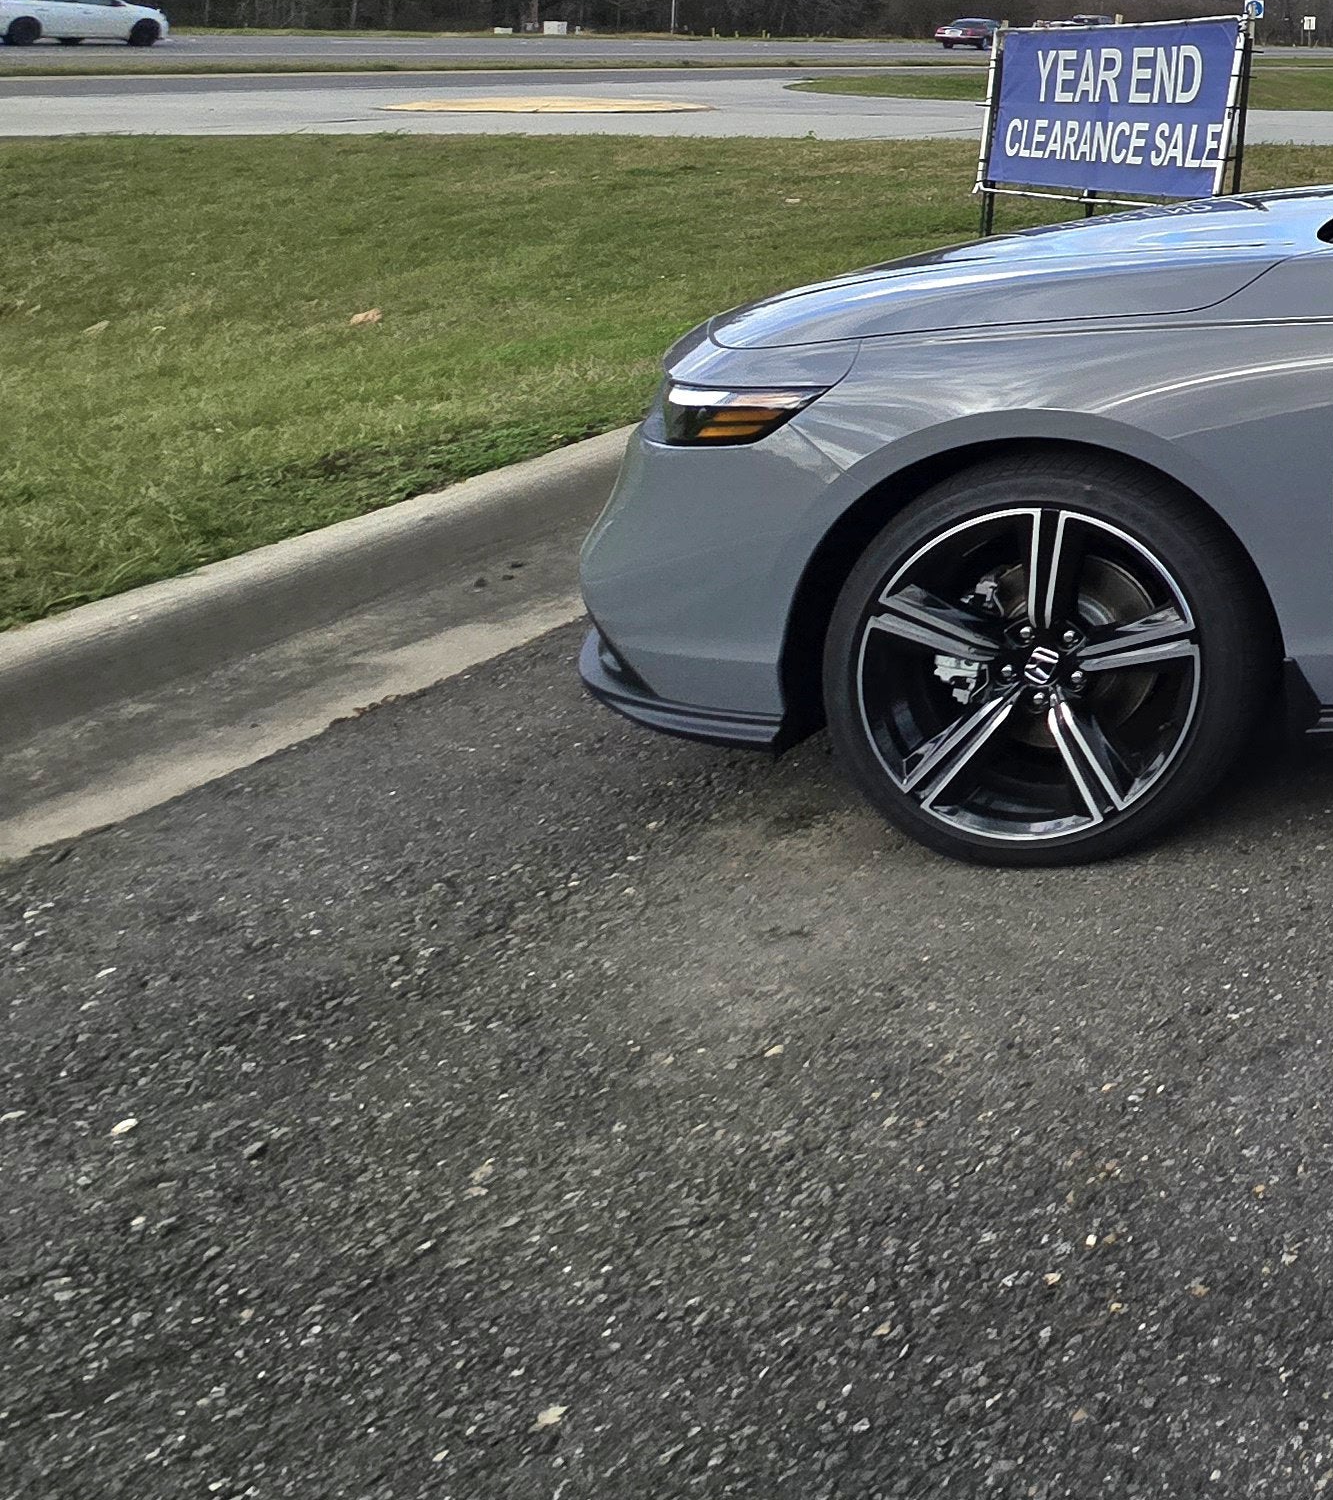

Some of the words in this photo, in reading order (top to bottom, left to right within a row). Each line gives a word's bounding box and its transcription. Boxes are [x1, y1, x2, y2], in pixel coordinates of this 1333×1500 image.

[1037, 47, 1123, 104] YEAR
[1128, 44, 1204, 105] END
[1004, 117, 1150, 166] CLEARANCE
[1150, 122, 1225, 169] SALE
